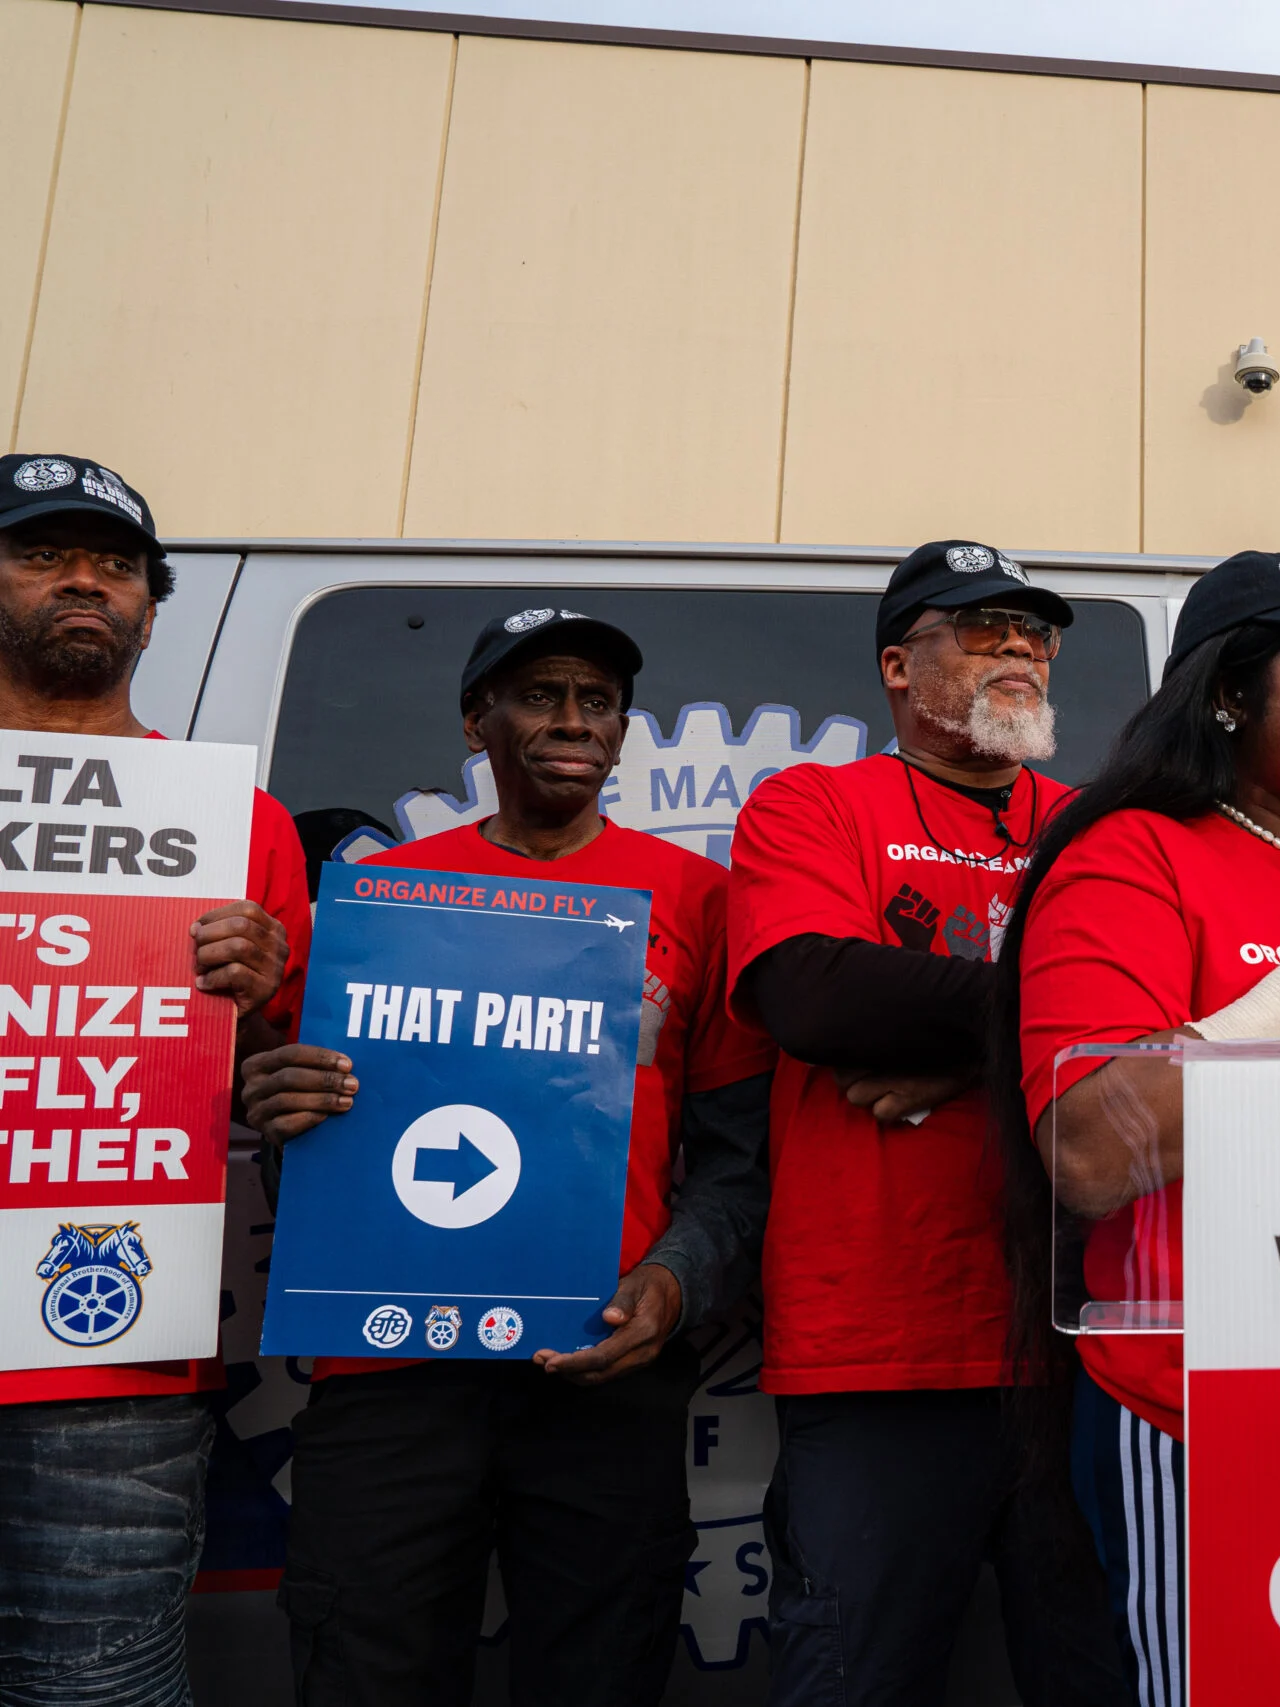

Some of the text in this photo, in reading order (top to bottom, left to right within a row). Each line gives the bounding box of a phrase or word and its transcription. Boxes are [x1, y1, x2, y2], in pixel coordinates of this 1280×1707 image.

[82, 477, 106, 492] HIS
[84, 487, 96, 496] IS
[97, 490, 117, 505] OUR
[354, 878, 598, 917] ORGANIZE AND FLY
[346, 982, 605, 1055] THAT PART!
[0, 1128, 190, 1183] HER
[50, 1267, 136, 1322] International Brotherhood of Teamsters
